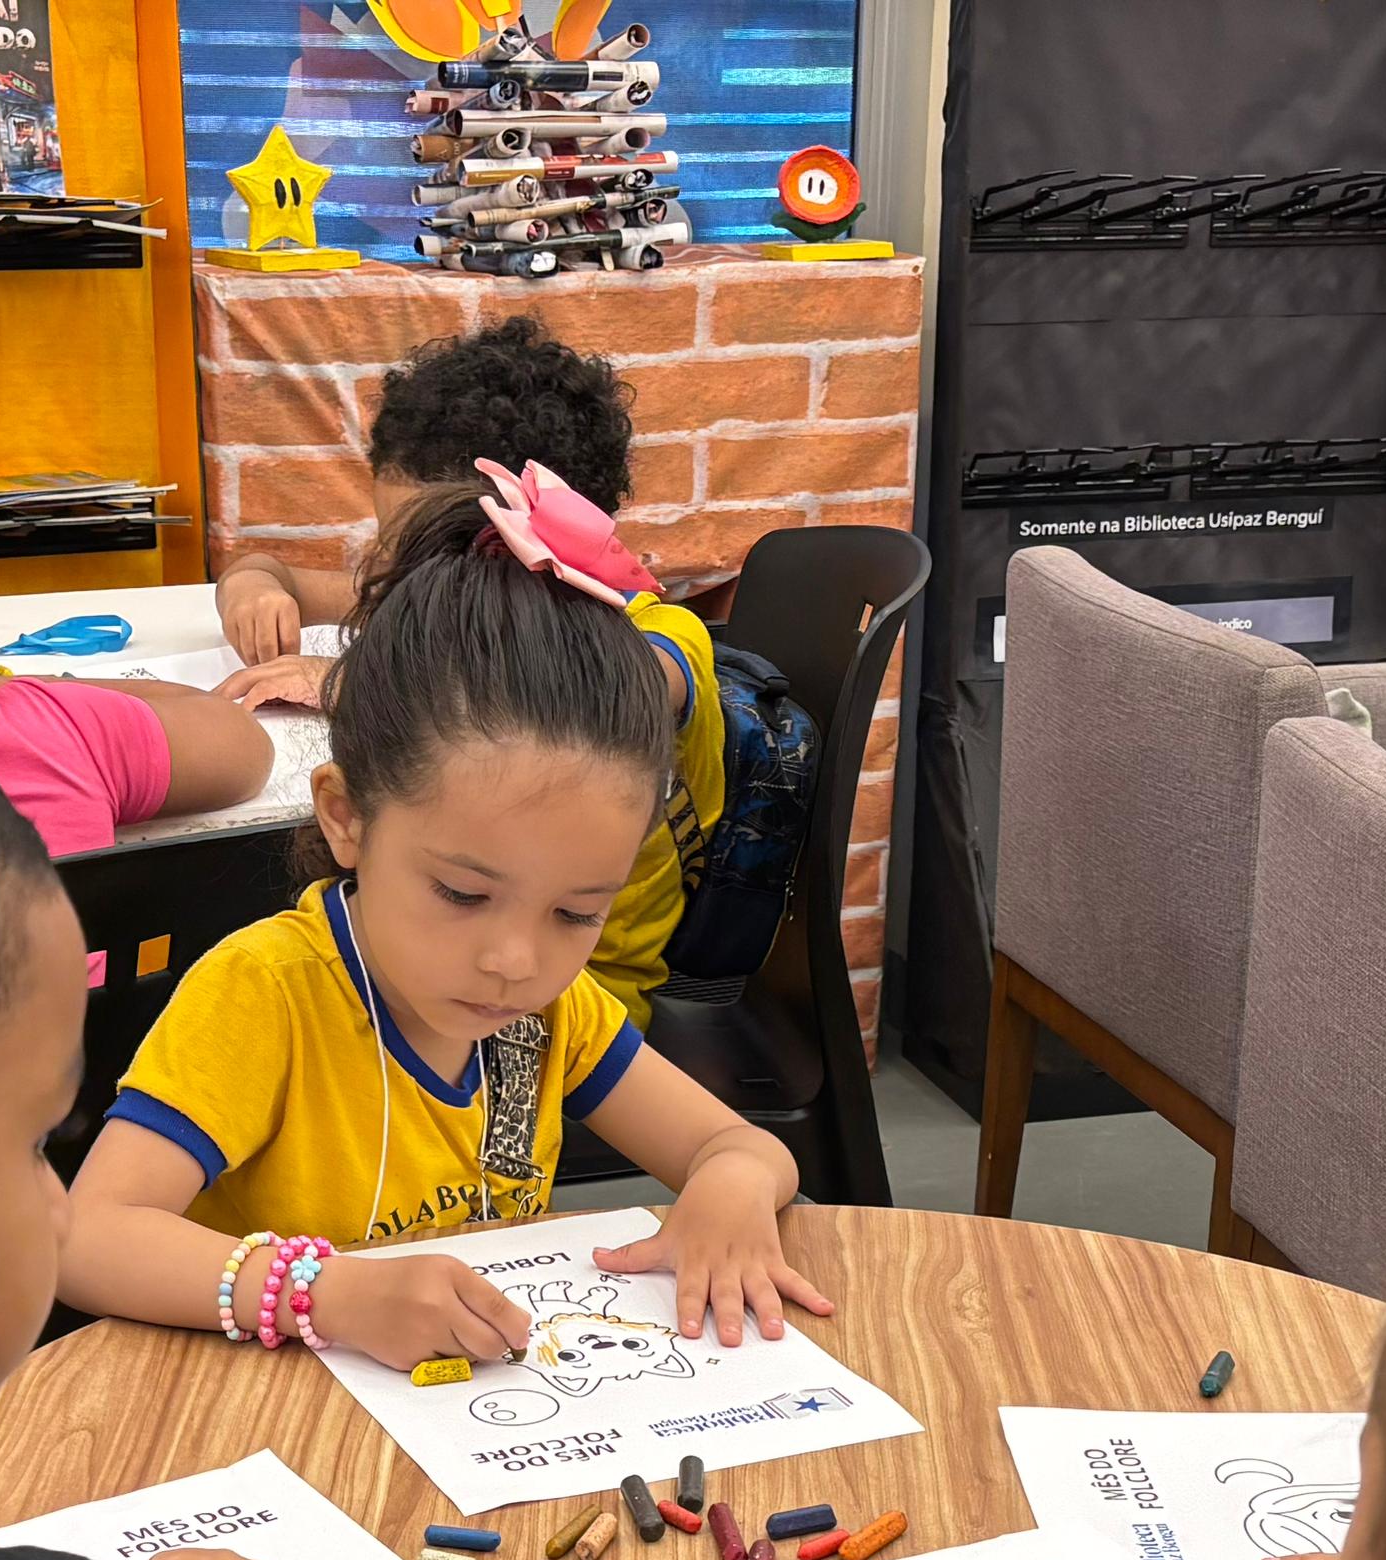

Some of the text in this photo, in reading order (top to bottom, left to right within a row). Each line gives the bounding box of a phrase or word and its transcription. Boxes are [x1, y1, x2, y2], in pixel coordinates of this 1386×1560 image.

[1019, 508, 1324, 537] Somente na Biblioteca Usipaz Benguí
[654, 1404, 776, 1437] Biblioteca
[471, 1428, 623, 1464] FOLCLORE
[503, 1443, 616, 1472] MÊS DO
[1084, 1449, 1128, 1501] MÊS DO
[1109, 1438, 1164, 1509] FOLCLORE
[117, 1510, 278, 1558] FOLCLORE
[123, 1505, 242, 1541] MÊS DO
